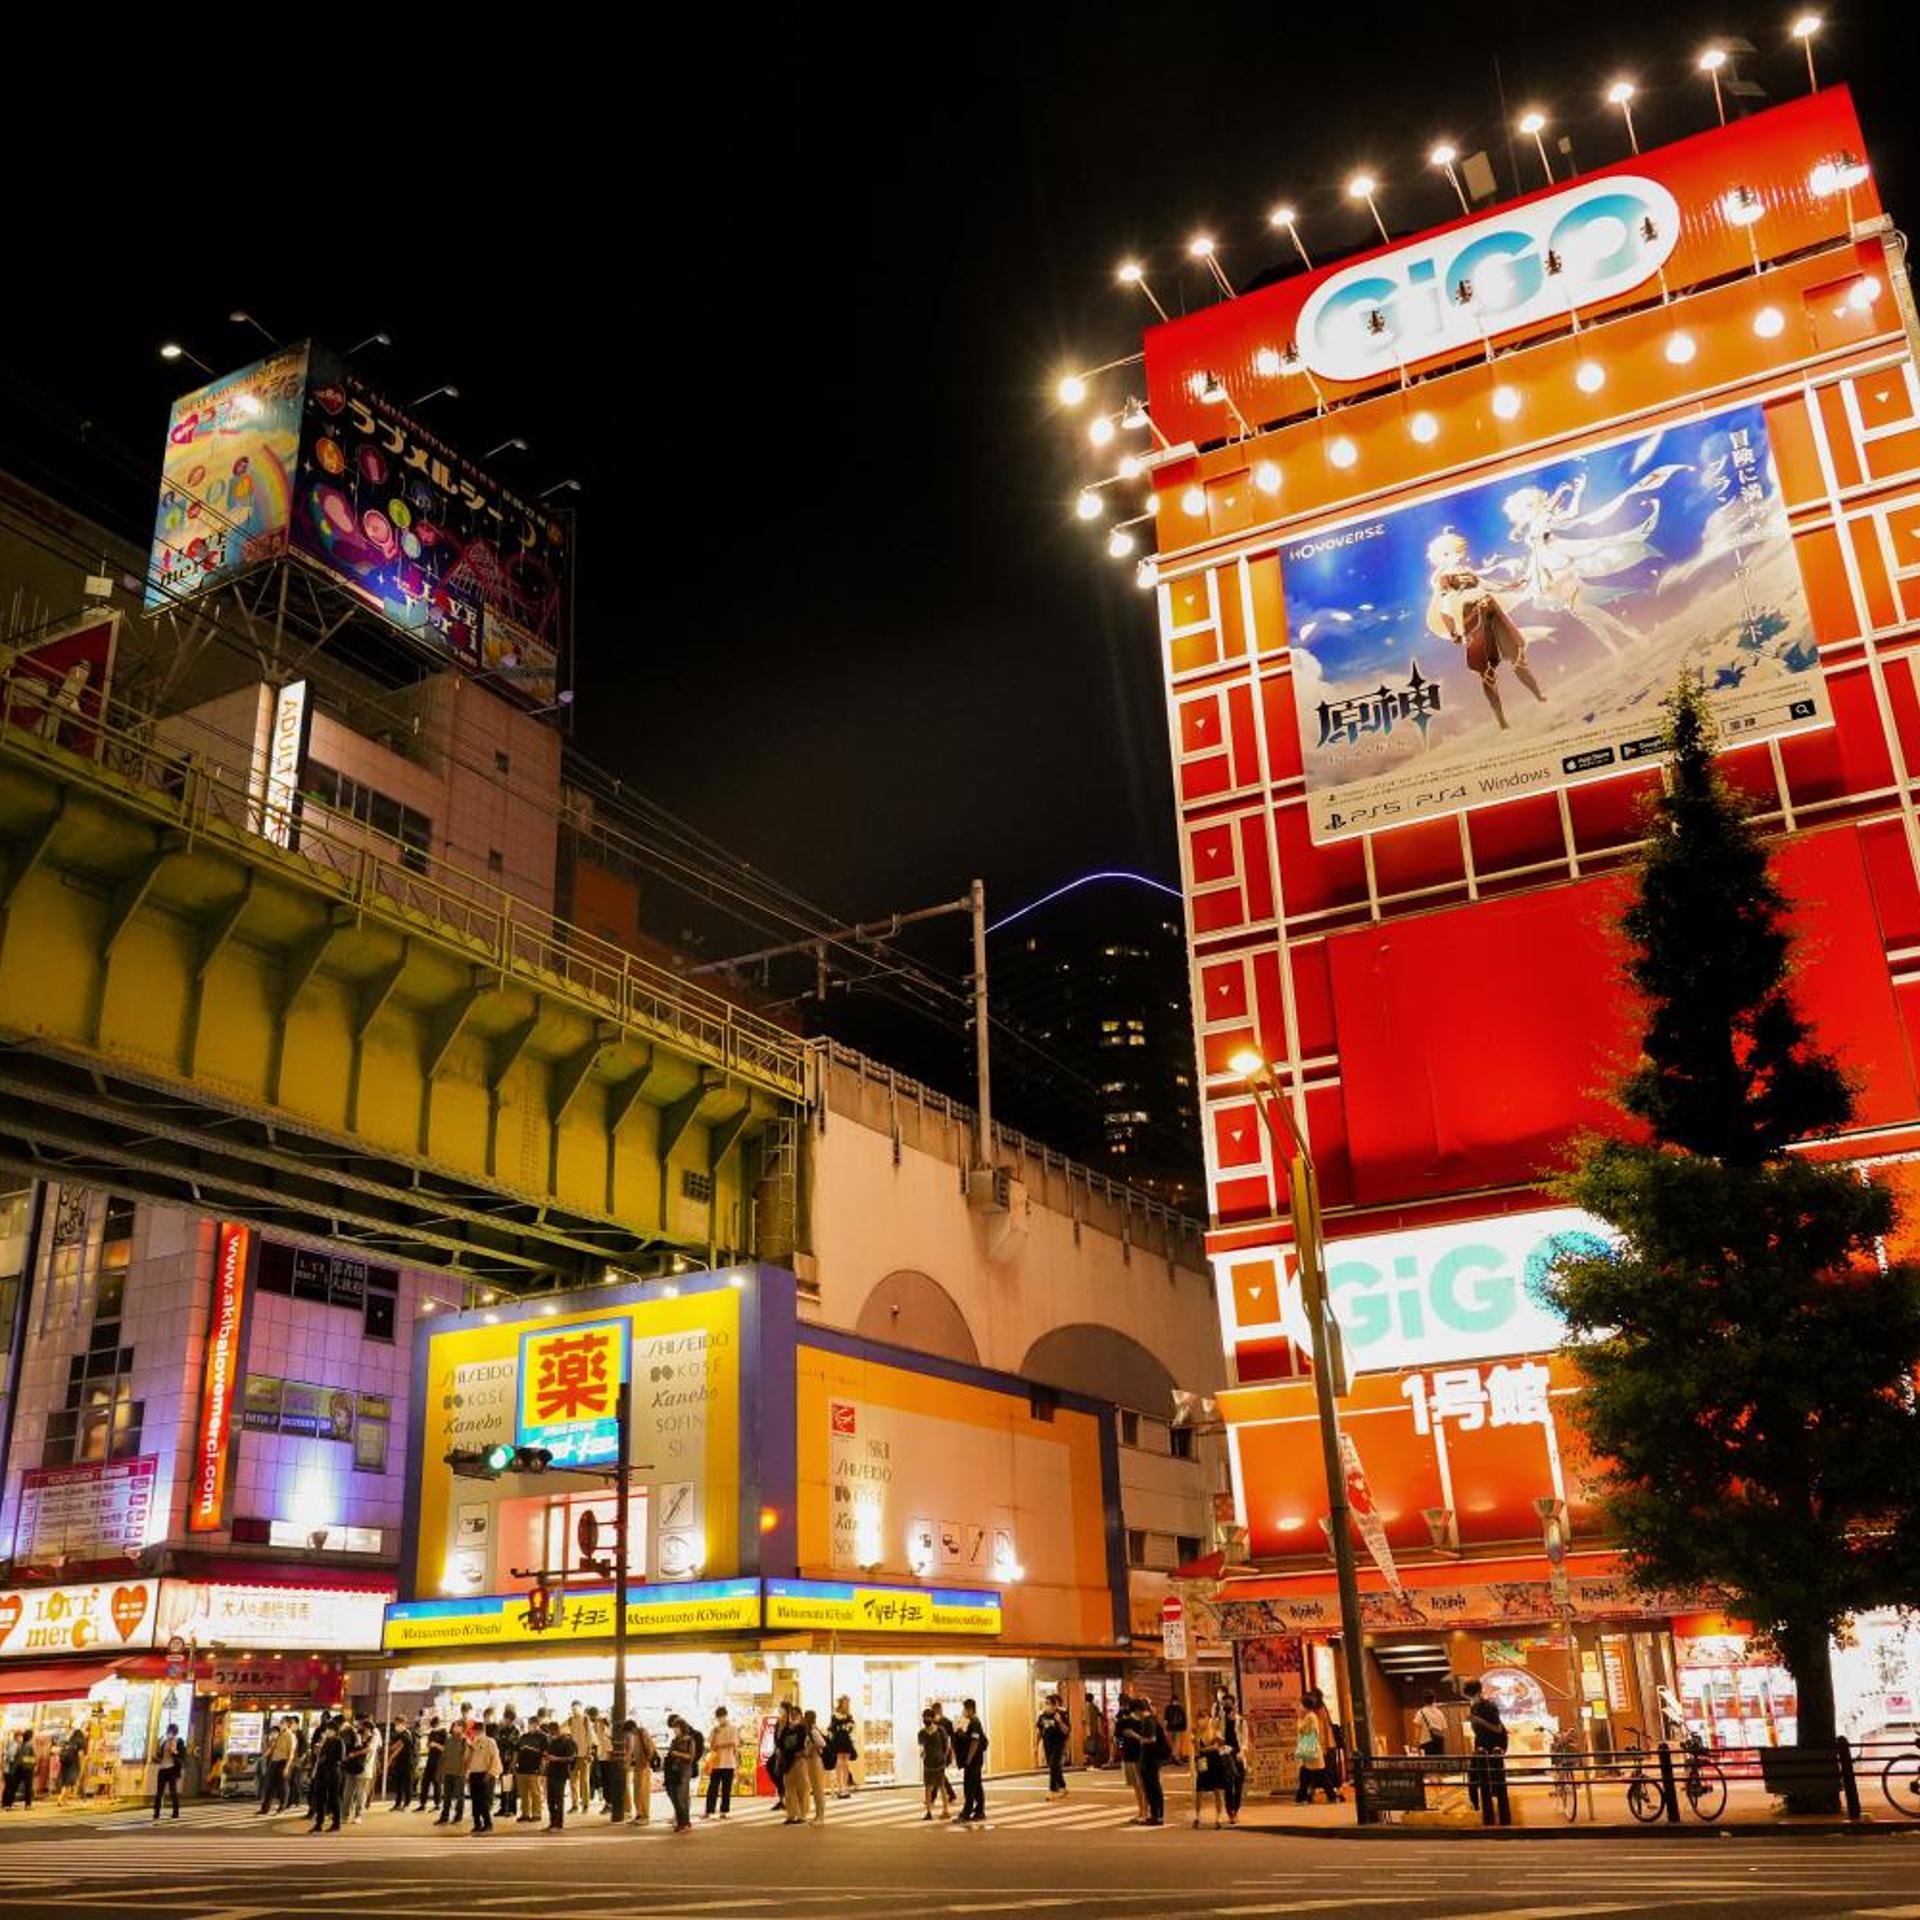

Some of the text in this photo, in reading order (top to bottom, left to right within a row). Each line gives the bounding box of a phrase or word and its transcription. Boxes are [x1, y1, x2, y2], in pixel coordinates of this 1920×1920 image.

[1314, 192, 1652, 352] GiGO
[1351, 802, 1401, 823] PS5
[1416, 785, 1467, 807] PS4
[1478, 767, 1551, 793] Windows
[536, 1333, 608, 1419] 薬
[651, 1384, 718, 1408] Kanebo
[1402, 1361, 1553, 1435] 1号館
[442, 1413, 502, 1435] Kanebo
[626, 1610, 694, 1627] Matsumoto
